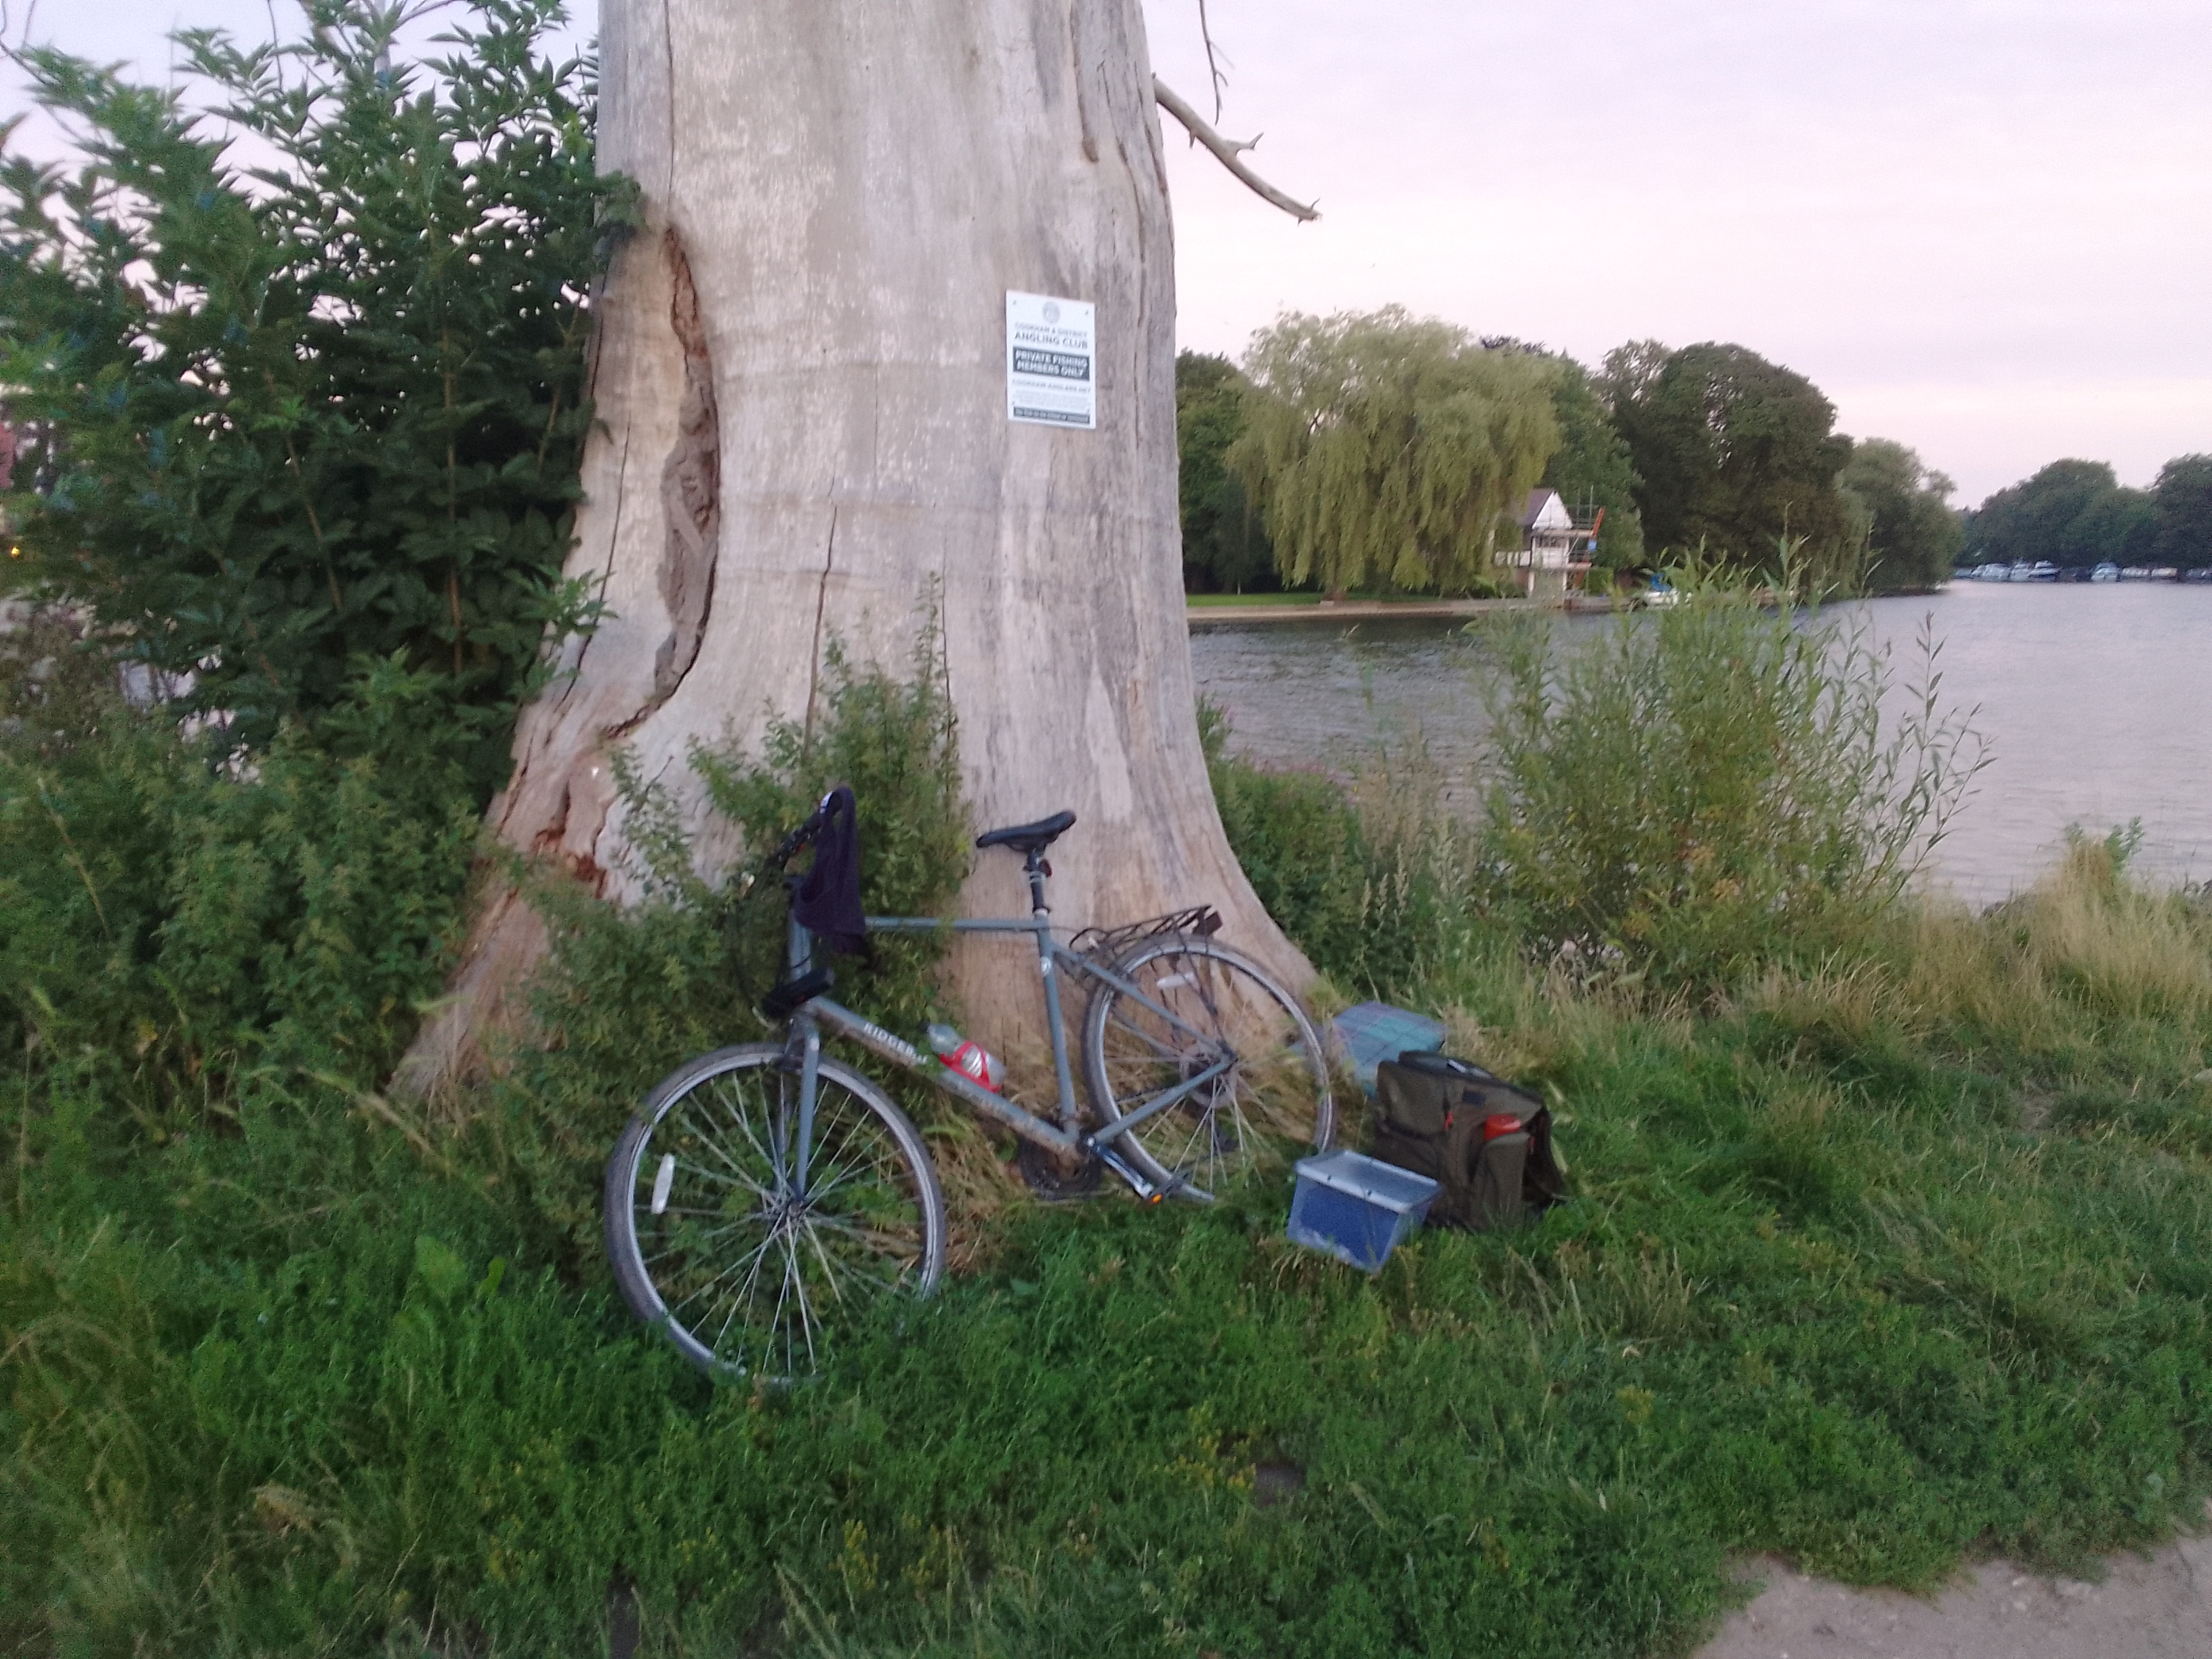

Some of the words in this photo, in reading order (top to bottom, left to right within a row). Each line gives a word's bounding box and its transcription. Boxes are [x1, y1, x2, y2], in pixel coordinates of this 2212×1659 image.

[1015, 331, 1059, 345] ANGLING
[1063, 338, 1088, 349] CLUB
[1016, 350, 1052, 363] PRIVATE
[1017, 360, 1059, 375] MEMBERS
[1061, 366, 1084, 379] ONLY
